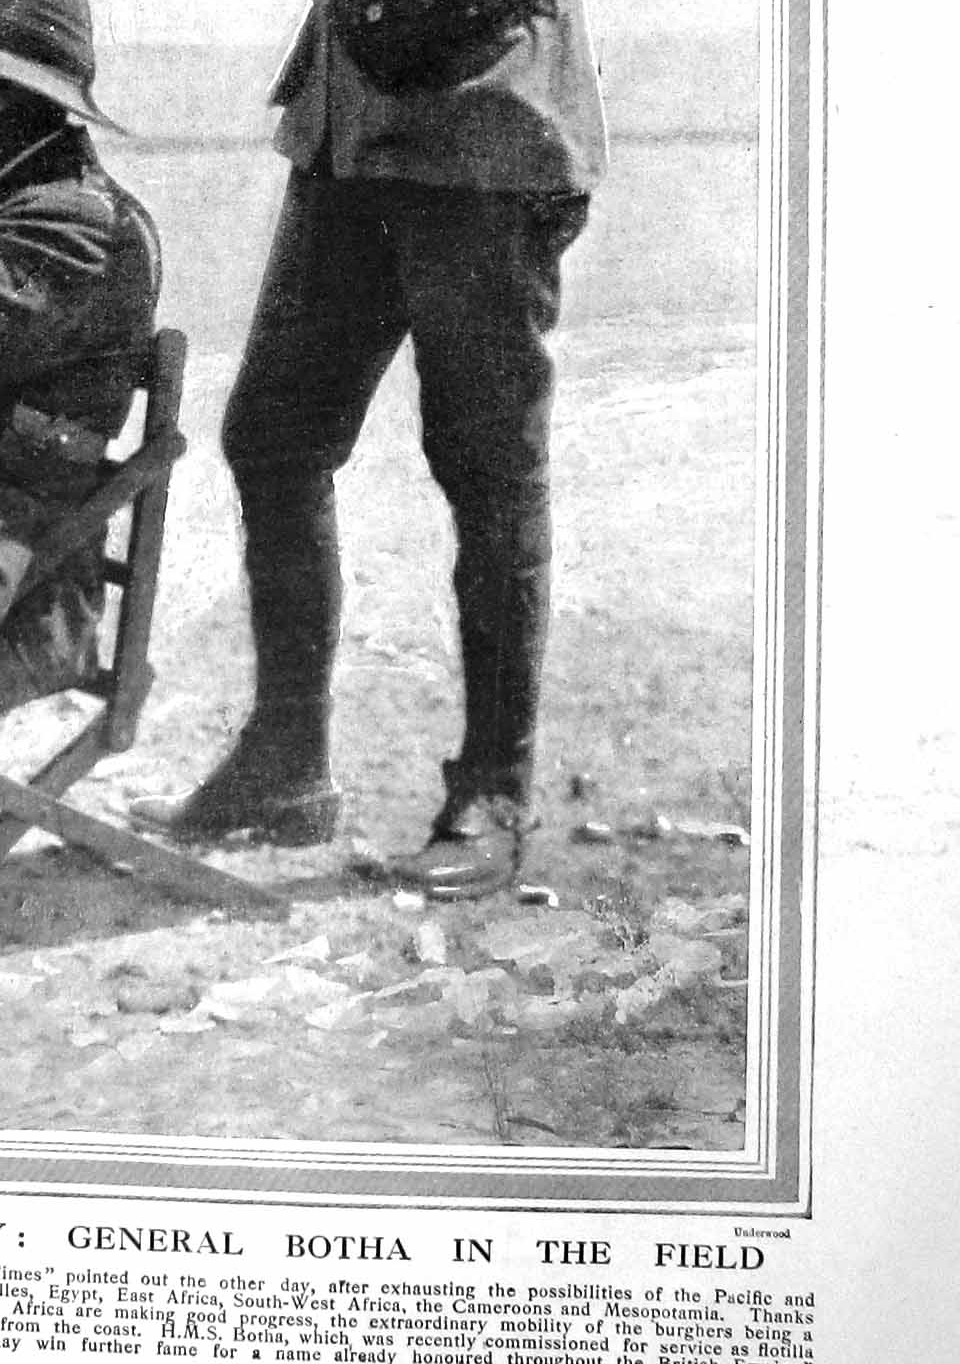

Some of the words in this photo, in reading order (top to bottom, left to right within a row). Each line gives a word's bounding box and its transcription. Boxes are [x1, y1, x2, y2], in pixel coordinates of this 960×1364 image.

[67, 1224, 244, 1256] GENERAL
[286, 1234, 412, 1262] BOTHA
[452, 1238, 494, 1264] IN
[535, 1240, 612, 1266] THE
[654, 1242, 765, 1271] FIELD
[733, 1226, 791, 1239] Underwood
[49, 1284, 103, 1306] Egypt,
[118, 1287, 154, 1304] East
[167, 1288, 224, 1309] Africa,
[233, 1291, 335, 1310] South-West
[348, 1295, 407, 1315] Africa,
[416, 1297, 443, 1314] the
[452, 1298, 552, 1317] Cameroons
[560, 1302, 591, 1319] and
[604, 1303, 725, 1324] Mesopotamia.
[750, 1307, 814, 1325] Thanks
[66, 1268, 129, 1288] pointed
[140, 1272, 167, 1288] out
[180, 1272, 206, 1289] the
[219, 1274, 265, 1291] other
[280, 1275, 316, 1297] day,
[328, 1277, 369, 1295] after
[380, 1279, 476, 1302] exhausting
[488, 1283, 516, 1299] the
[528, 1284, 632, 1304] possibilities
[644, 1287, 661, 1304] of
[674, 1288, 701, 1305] the
[714, 1289, 773, 1307] Pacific
[784, 1291, 815, 1308] and
[1, 1316, 40, 1334] from
[54, 1319, 81, 1335] the
[93, 1322, 142, 1338] coast.
[161, 1322, 222, 1341] H.M.S.
[233, 1325, 289, 1345] Botha,
[299, 1327, 349, 1345] which
[362, 1334, 394, 1346] was
[407, 1332, 476, 1353] recently
[484, 1334, 609, 1353] commissioned
[623, 1337, 649, 1354] for
[660, 1339, 722, 1356] service
[730, 1345, 749, 1357] as
[758, 1341, 814, 1359] flotilla
[12, 1300, 64, 1318] Africa
[75, 1307, 102, 1319] are
[114, 1304, 175, 1326] making
[186, 1307, 227, 1327] good
[239, 1313, 318, 1329] progress,
[330, 1311, 358, 1328] the
[369, 1314, 487, 1336] extraordinary
[500, 1317, 572, 1339] mobility
[585, 1319, 604, 1336] of
[615, 1320, 642, 1337] the
[655, 1321, 733, 1343] burghers
[744, 1324, 792, 1345] being
[803, 1330, 813, 1342] a
